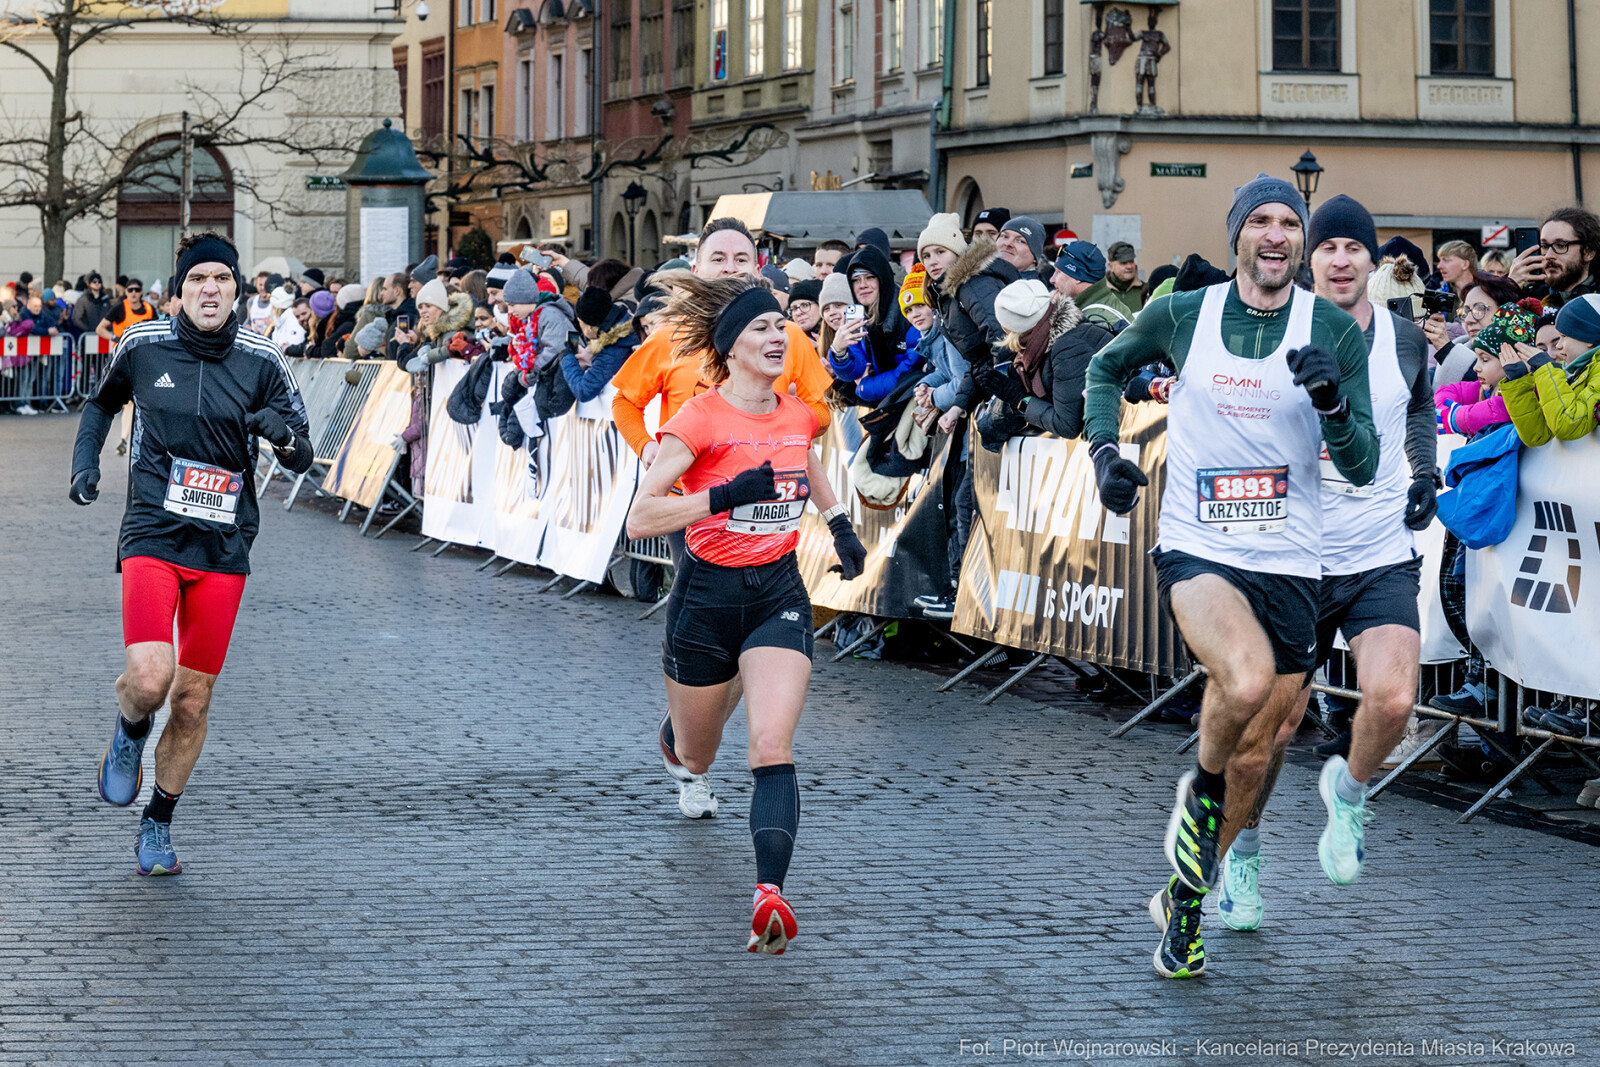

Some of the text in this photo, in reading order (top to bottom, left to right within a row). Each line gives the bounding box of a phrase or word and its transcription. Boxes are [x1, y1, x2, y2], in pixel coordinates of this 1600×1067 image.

[1155, 167, 1202, 176] MARIACKI
[1245, 307, 1273, 318] CRAFT
[154, 381, 175, 389] adidas
[1212, 374, 1262, 389] OMNI
[1211, 383, 1281, 401] RUNNING
[1216, 402, 1272, 413] SUPLEMENTY
[1216, 409, 1232, 417] DLA
[188, 470, 225, 491] 2217
[1216, 477, 1274, 499] 3893
[181, 488, 223, 508] SAVERIO
[774, 481, 797, 501] 52
[752, 503, 790, 520] MAGDA
[1208, 500, 1282, 519] KRZYSZTOF
[1043, 577, 1124, 629] is SPORT
